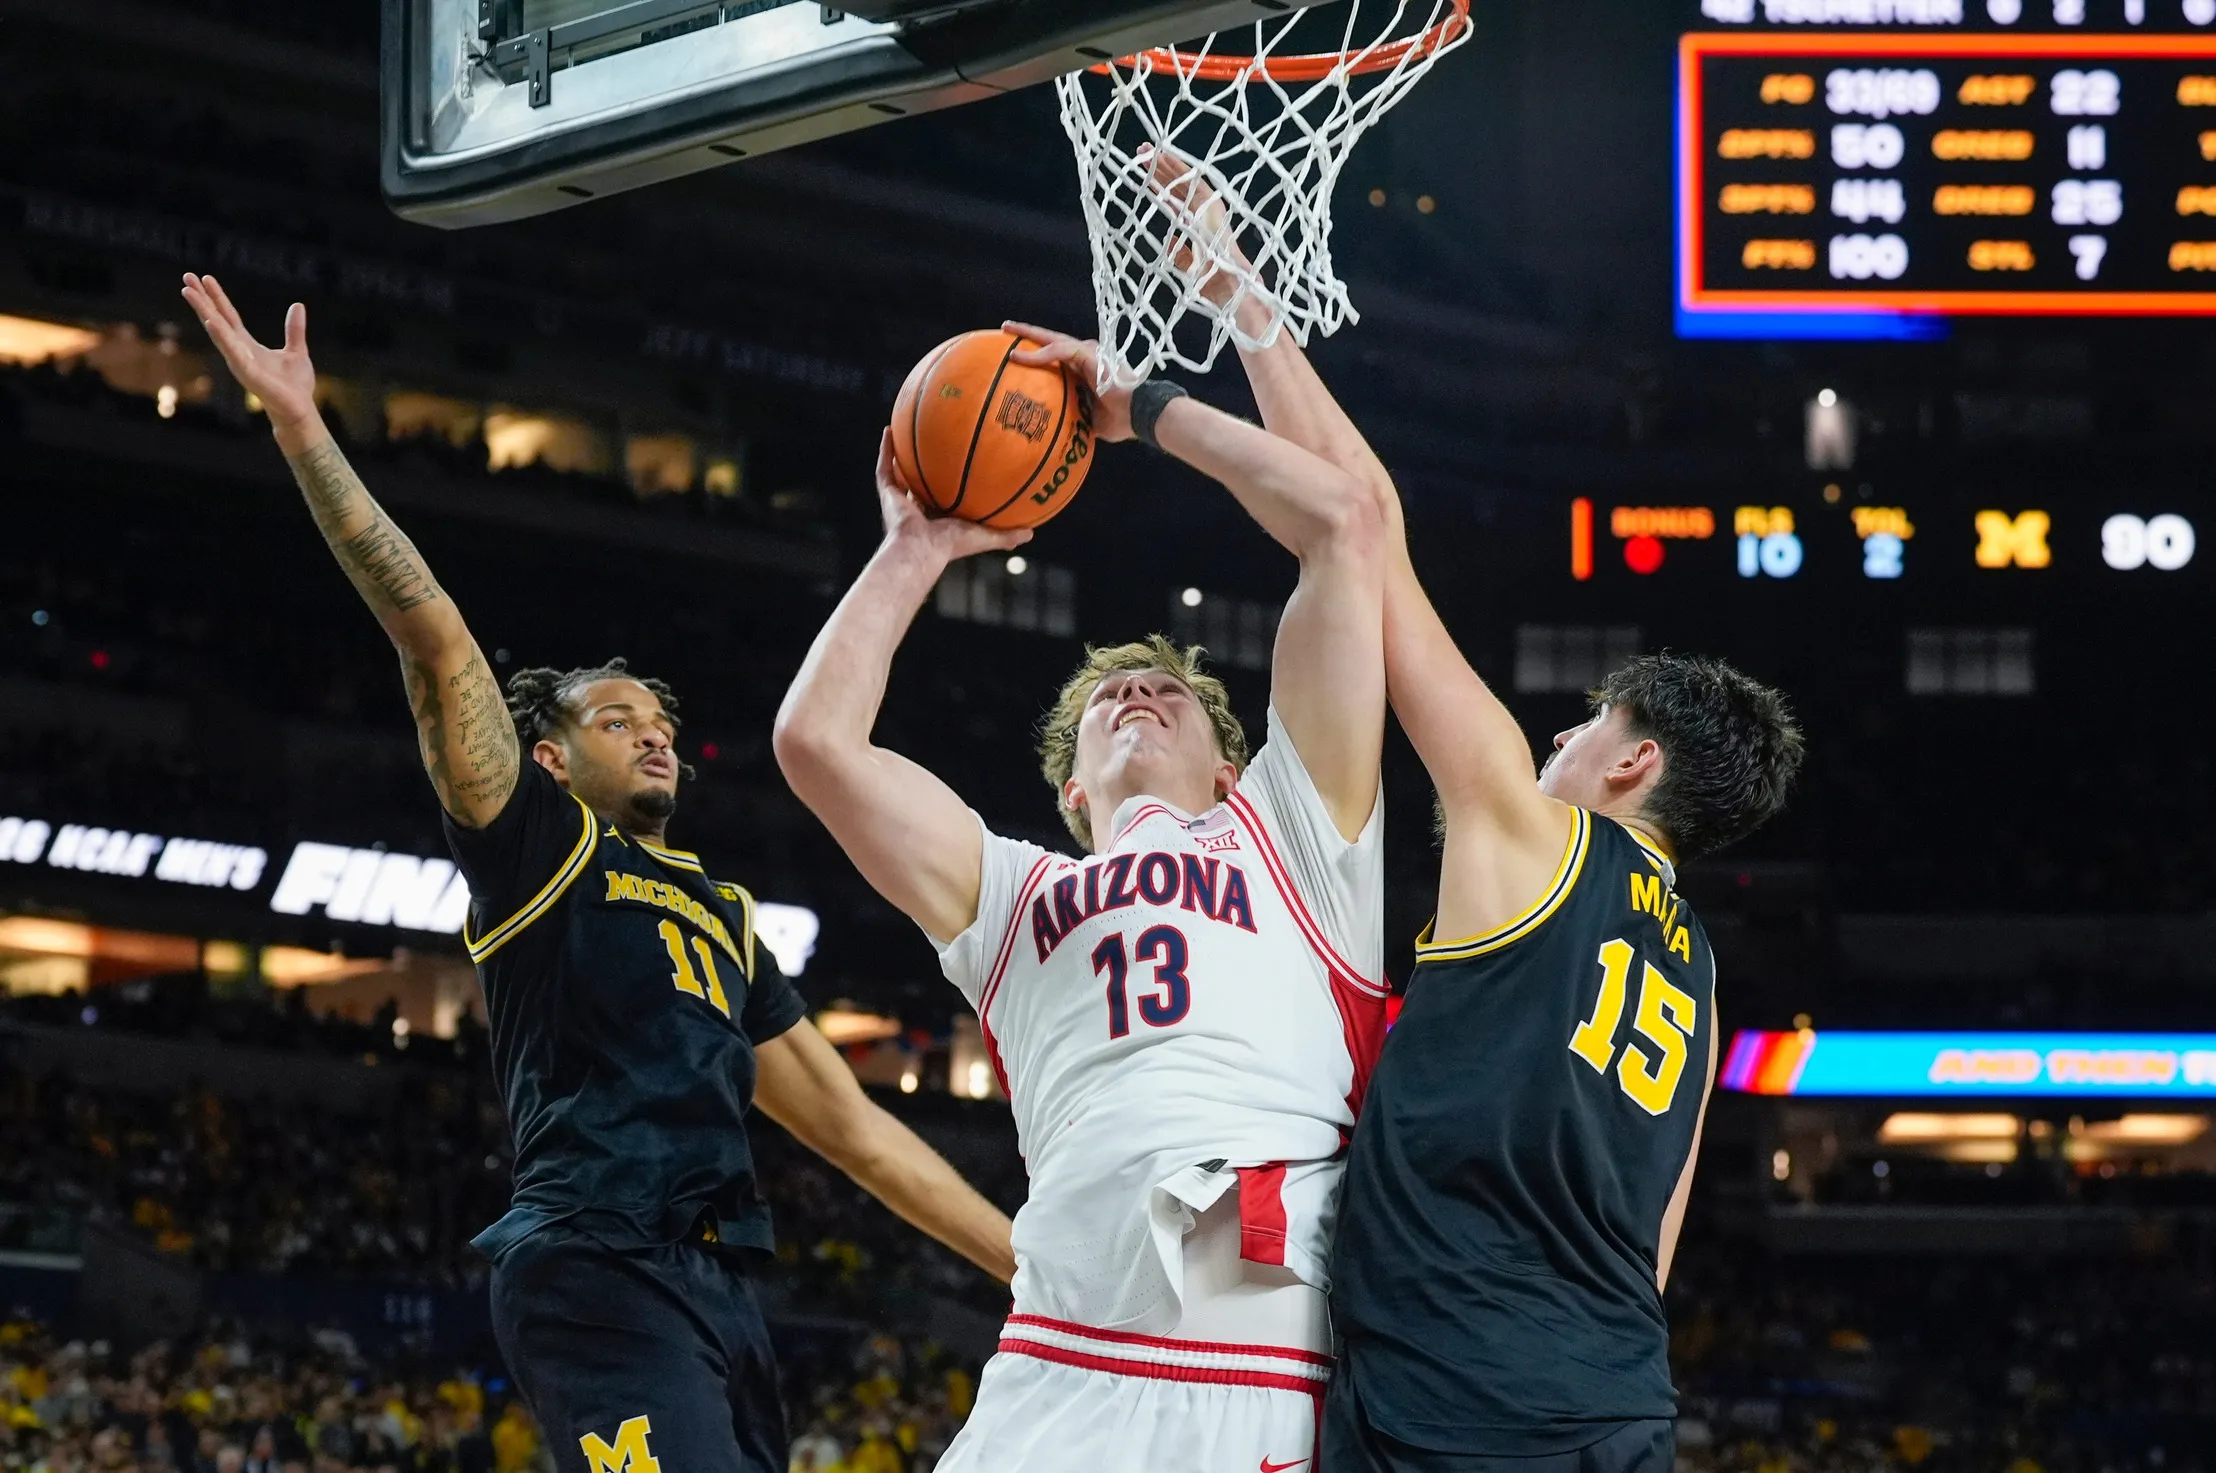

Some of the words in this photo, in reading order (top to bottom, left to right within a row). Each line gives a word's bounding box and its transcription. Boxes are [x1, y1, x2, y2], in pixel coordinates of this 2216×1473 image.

[2051, 70, 2120, 115] 22
[1831, 124, 1904, 169] 50
[2067, 124, 2106, 170] 11
[1831, 179, 1905, 224] 44
[2051, 180, 2123, 225] 25
[1829, 234, 1908, 279] 100
[2068, 235, 2107, 280] 7
[1738, 532, 1803, 578] 10
[1864, 532, 1903, 578] 2
[1975, 510, 2051, 568] M
[2101, 514, 2195, 570] 90
[270, 841, 472, 934] FINA
[1032, 852, 1258, 965] ARIZONA
[658, 918, 732, 1020] 11
[1091, 924, 1191, 1040] 13
[1568, 938, 1697, 1117] 15
[579, 1414, 663, 1473] M
